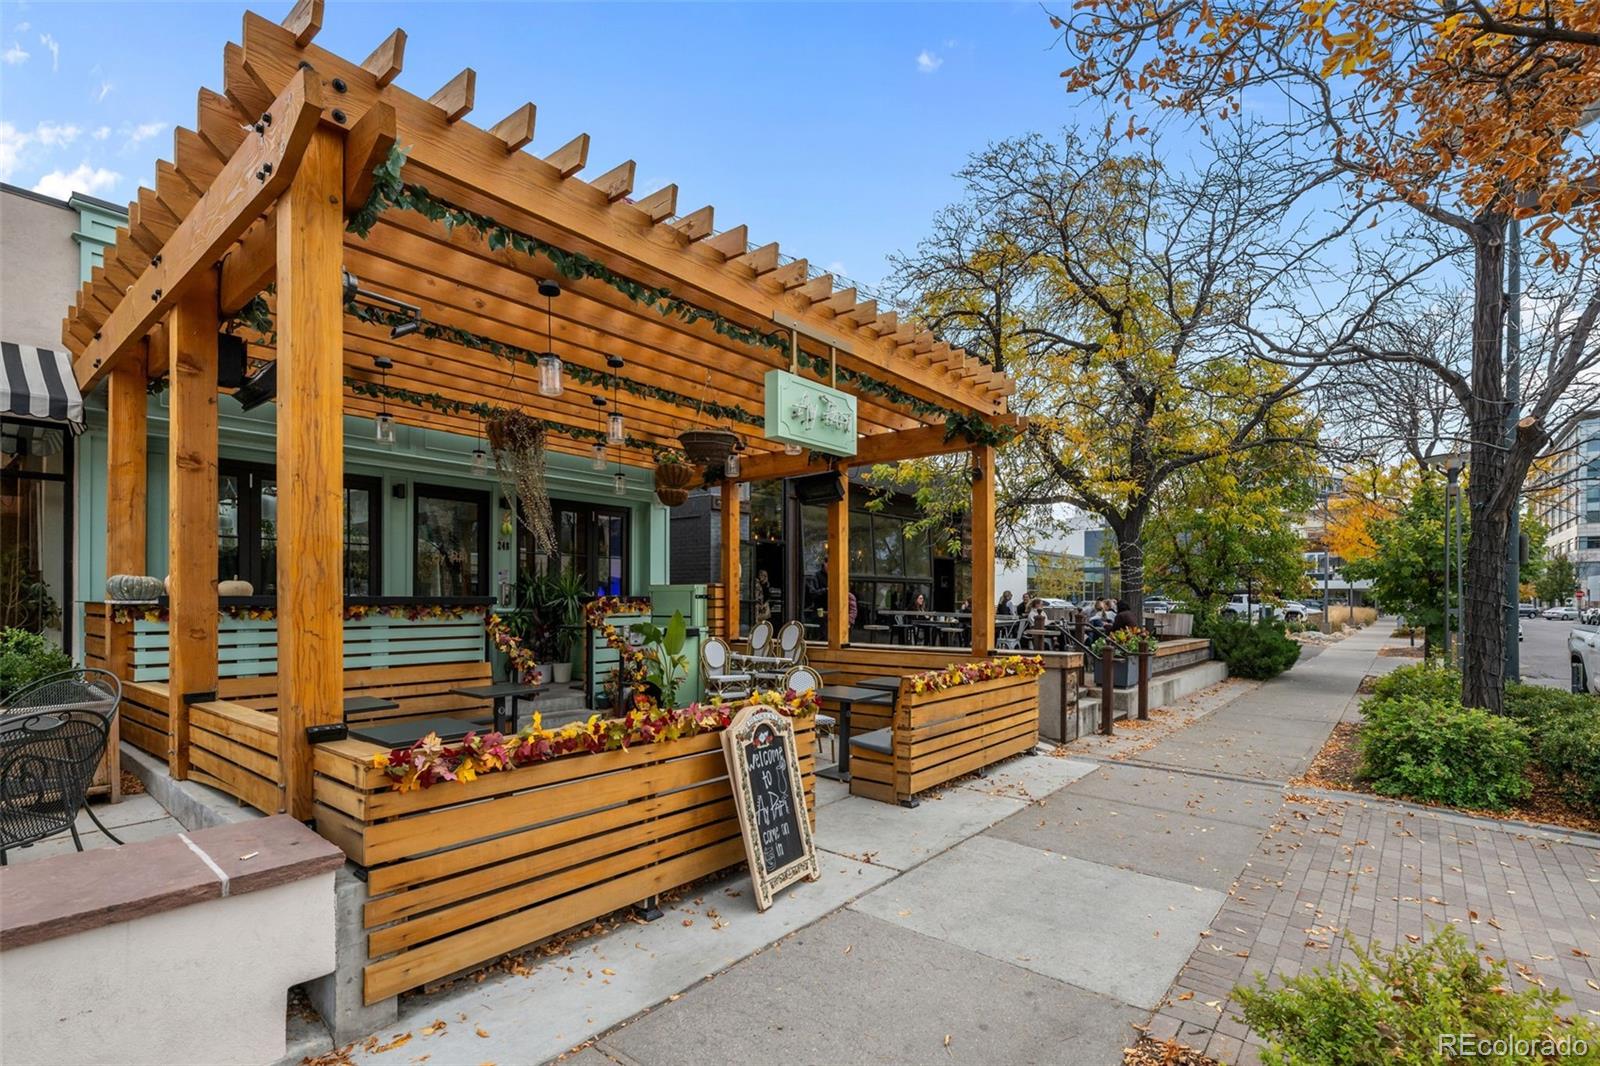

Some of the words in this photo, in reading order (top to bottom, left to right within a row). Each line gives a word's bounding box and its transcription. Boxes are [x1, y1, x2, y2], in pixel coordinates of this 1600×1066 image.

[762, 770, 772, 789] to
[762, 826, 780, 845] come
[775, 842, 784, 857] in
